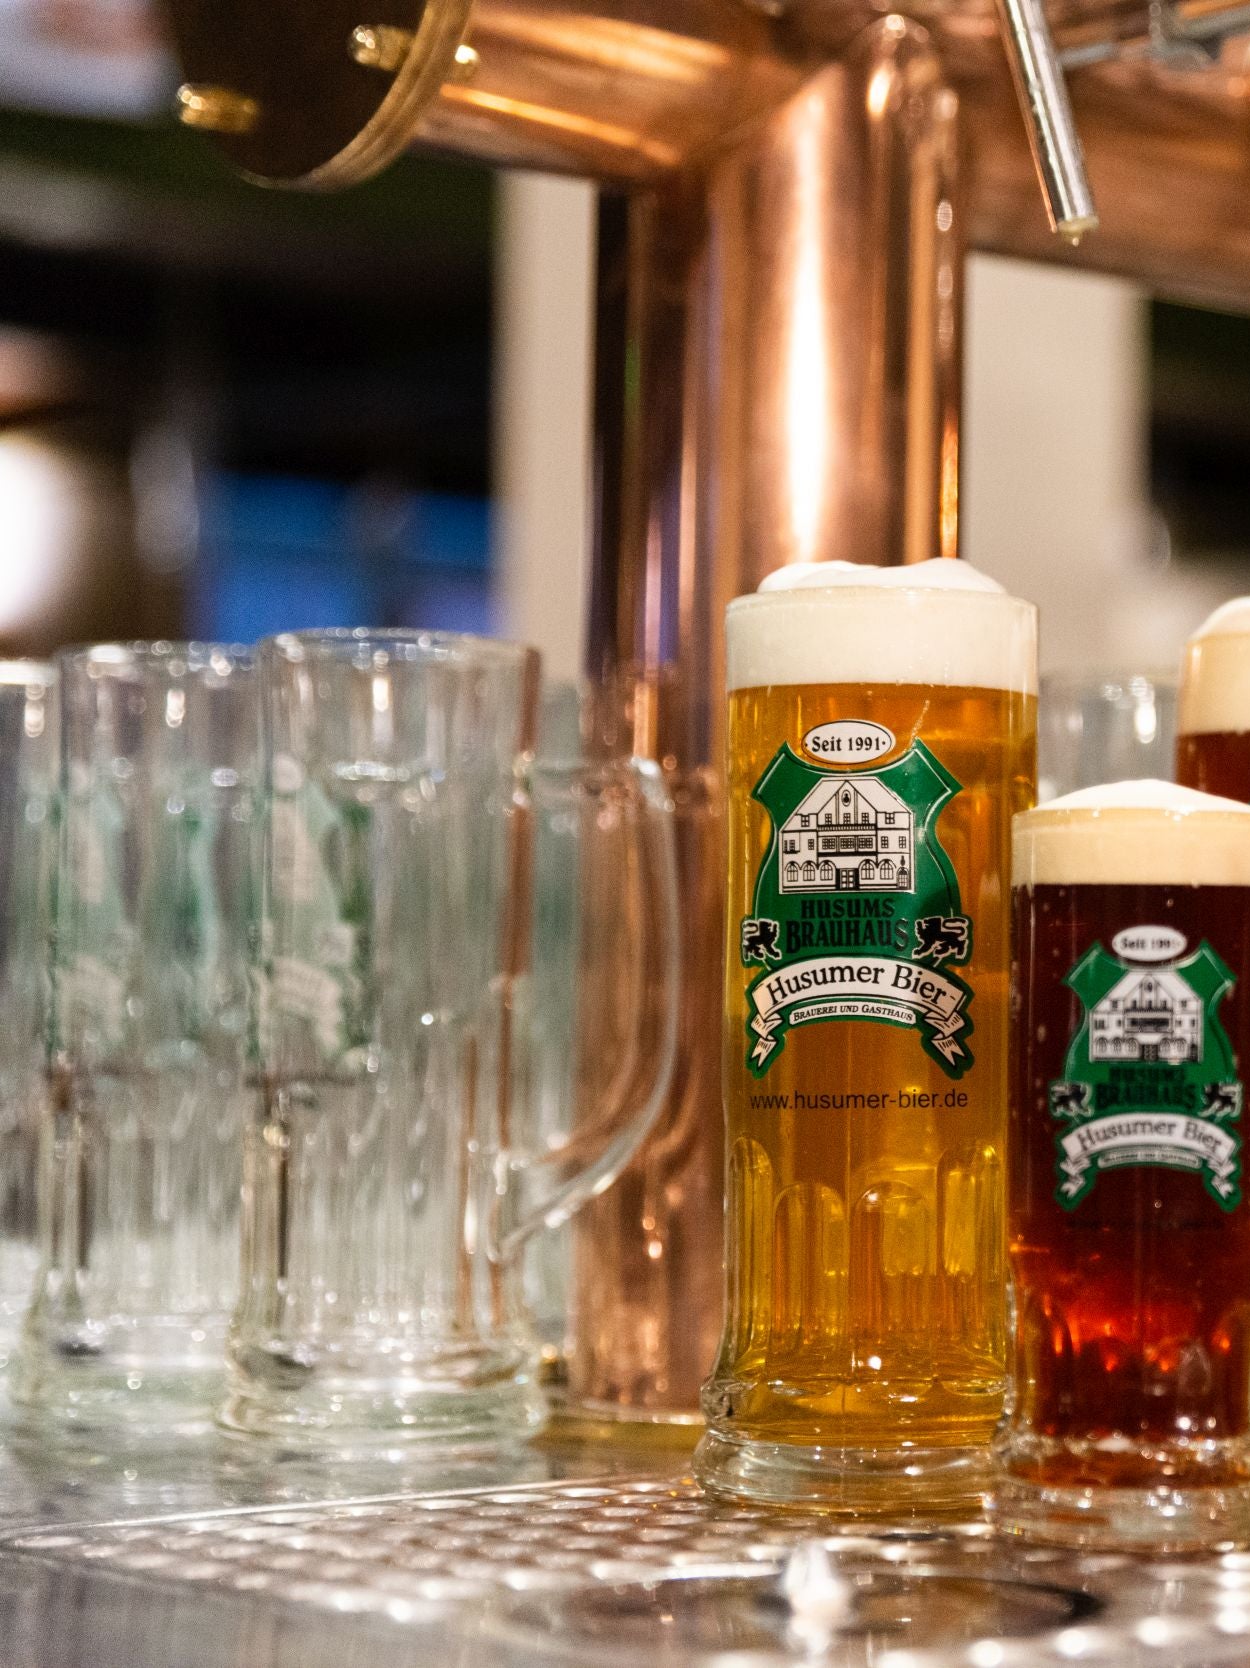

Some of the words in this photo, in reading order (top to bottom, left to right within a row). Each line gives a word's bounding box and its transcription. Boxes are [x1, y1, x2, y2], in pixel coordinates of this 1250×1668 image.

[812, 736, 842, 751] Seit
[847, 736, 881, 751] 1991
[801, 898, 896, 918] HUSUMS
[785, 917, 910, 954] BRAUHAUS
[765, 964, 885, 1006] Husumer
[891, 964, 947, 1005] Bier
[793, 1004, 838, 1022] BRAUEREI
[839, 1003, 859, 1014] UND
[861, 1003, 914, 1022] GASTHAUS
[750, 1088, 969, 1110] www.husumer-bier.de
[1076, 1117, 1176, 1151] Husumer
[1182, 1119, 1222, 1153] Bier
